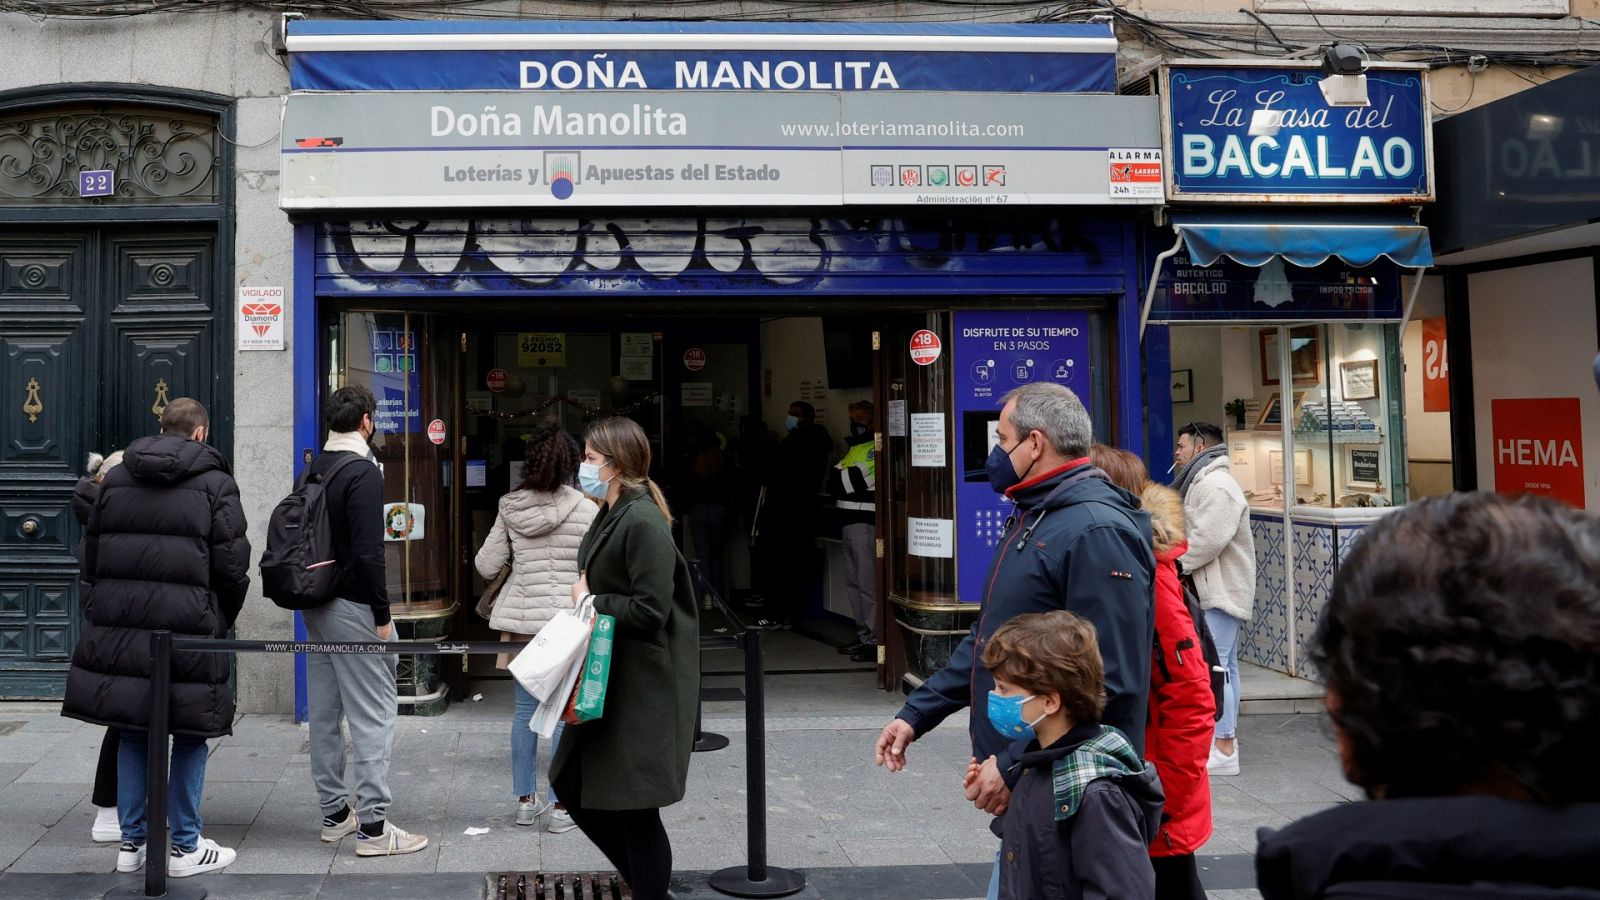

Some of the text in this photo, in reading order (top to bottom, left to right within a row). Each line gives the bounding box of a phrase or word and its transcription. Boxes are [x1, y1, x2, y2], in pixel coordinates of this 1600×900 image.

[520, 53, 900, 90] DOÑA MANOLITA
[1199, 89, 1246, 128] La
[1345, 94, 1393, 128] del
[430, 104, 687, 137] Doña Manolita
[780, 120, 1025, 137] www.loteriamanolita.com
[1109, 151, 1161, 160] ALARMA
[1182, 134, 1416, 180] BACALAO
[444, 165, 540, 185] Loterías y
[585, 163, 780, 183] Apuestas del Estado
[85, 175, 107, 191] 22
[1113, 186, 1130, 194] 24h
[916, 194, 982, 204] Administración
[996, 195, 1009, 203] 67
[241, 289, 282, 297] VIGILADO
[1174, 282, 1227, 294] BACALAO
[963, 328, 1079, 337] DISFRUTE DE SU TIEMPO
[915, 333, 932, 345] +18
[521, 343, 563, 353] 92052
[994, 341, 1050, 350] EN 3 PASOS
[374, 421, 399, 429] Estado
[1497, 438, 1579, 467] HEMA
[264, 642, 386, 653] WWW.LOTERIAMANOLITA.COM
